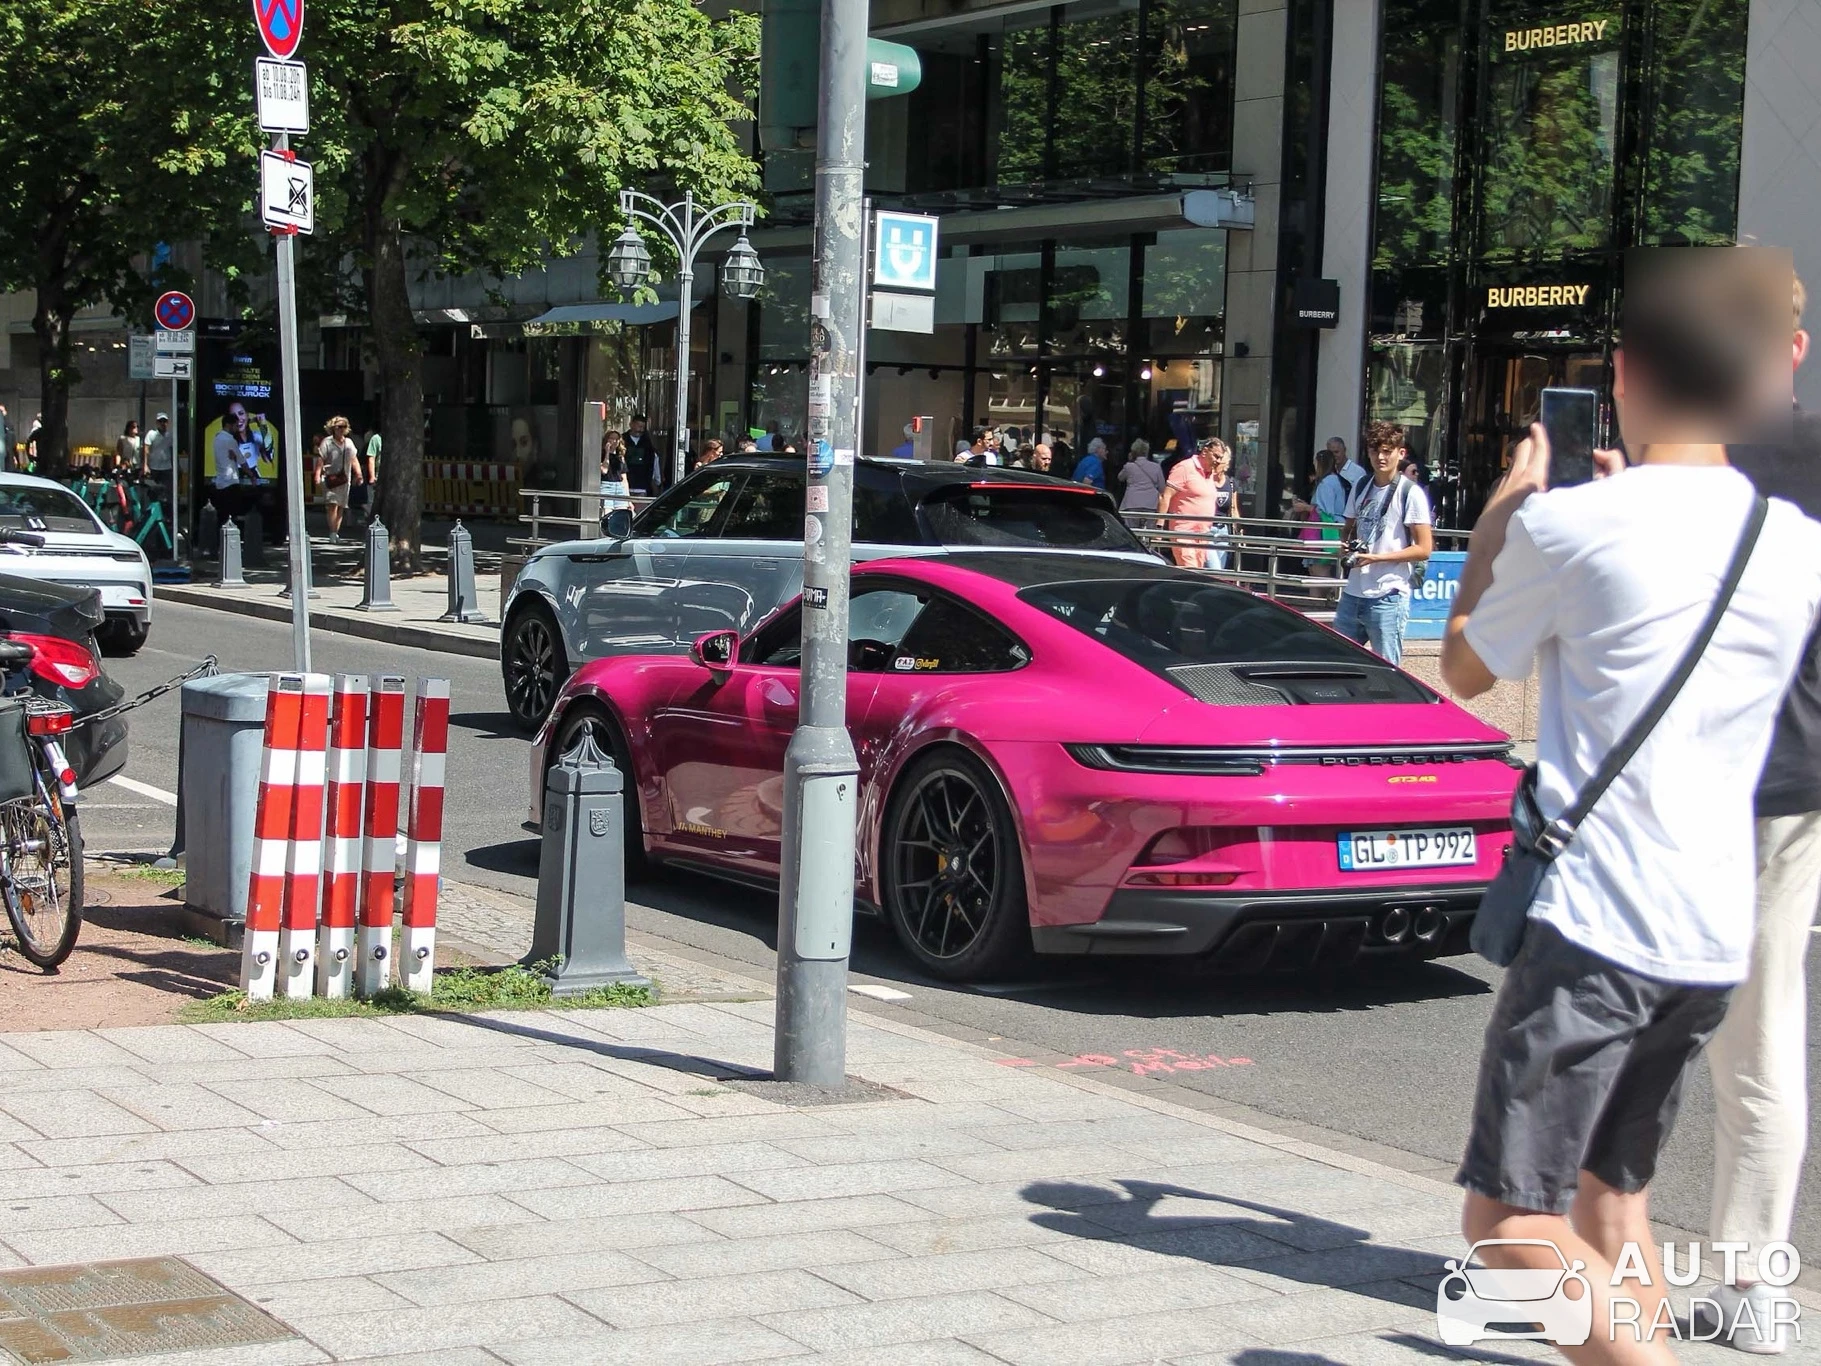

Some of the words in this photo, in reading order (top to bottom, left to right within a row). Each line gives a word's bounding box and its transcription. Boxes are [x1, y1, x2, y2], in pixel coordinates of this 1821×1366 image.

[1505, 19, 1608, 52] BURBERRY
[1488, 284, 1589, 308] BURBERRY
[1299, 310, 1335, 319] BURBERRY
[1321, 754, 1467, 766] PORSCHE
[689, 823, 729, 840] MANTHEY
[1353, 835, 1385, 864] GL
[1398, 833, 1429, 861] TP
[1433, 830, 1474, 860] 992
